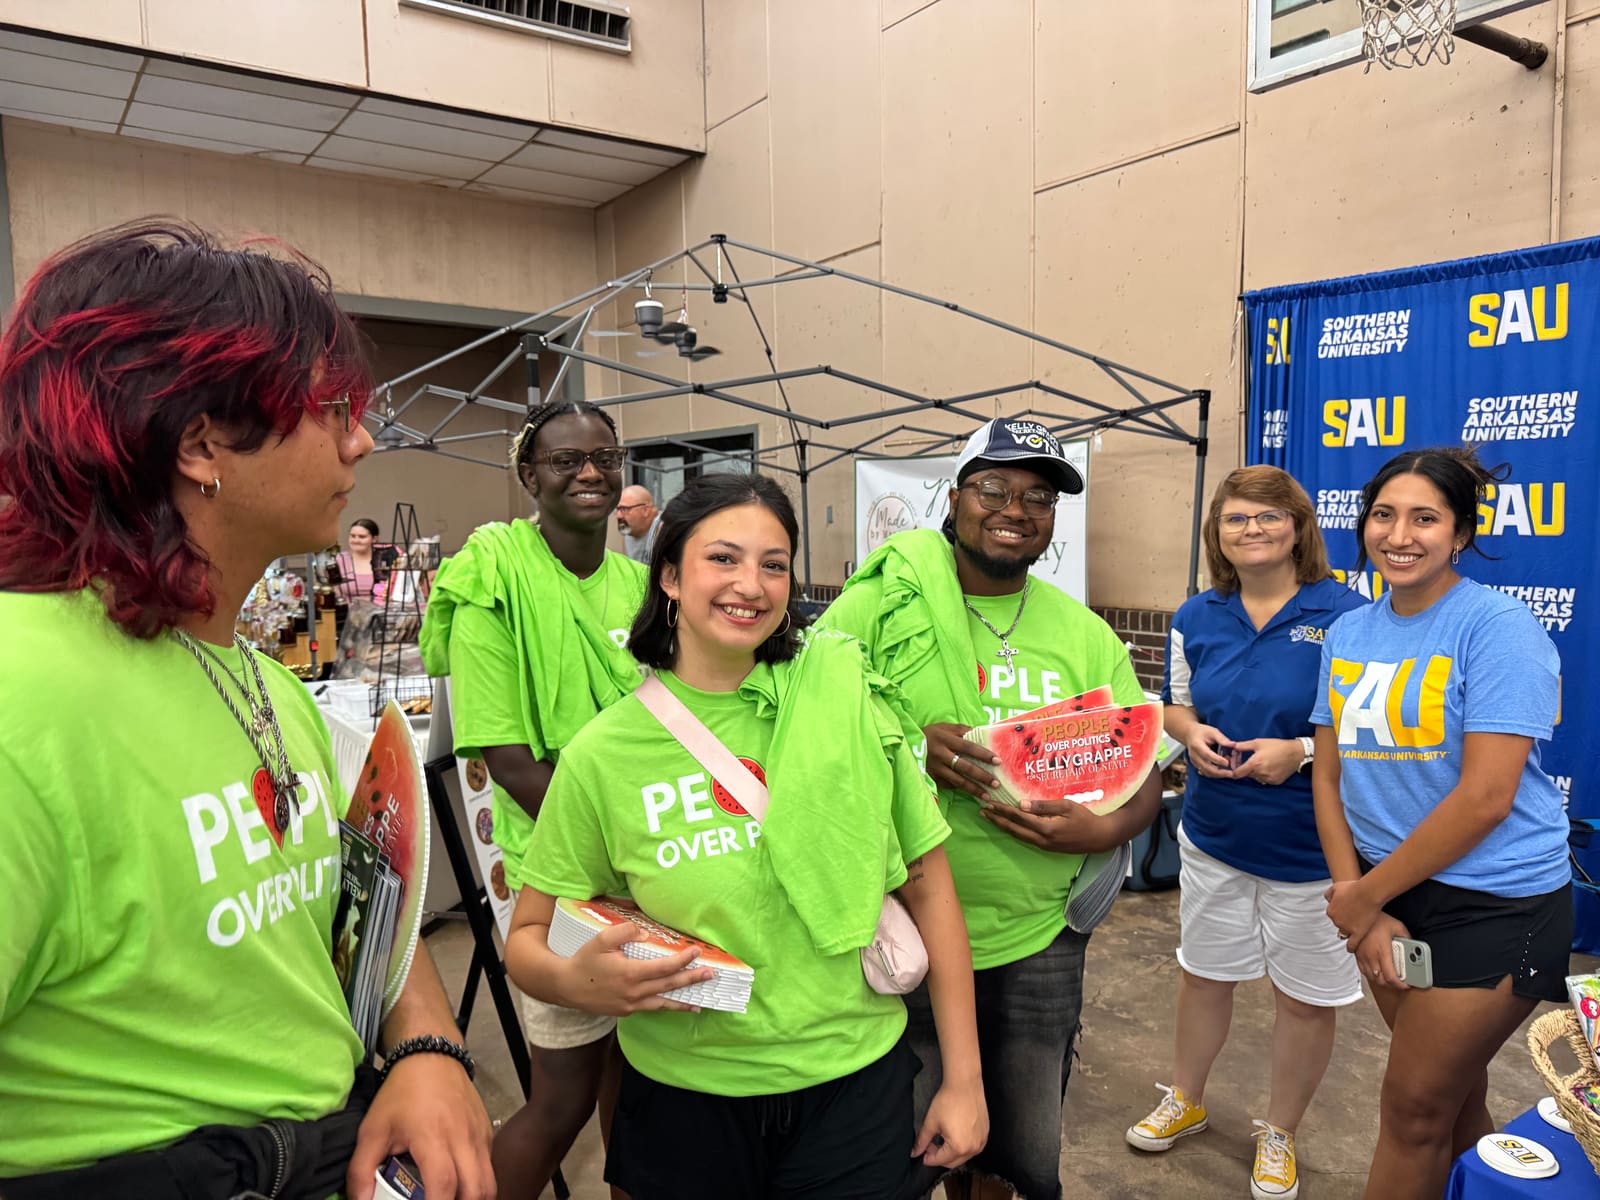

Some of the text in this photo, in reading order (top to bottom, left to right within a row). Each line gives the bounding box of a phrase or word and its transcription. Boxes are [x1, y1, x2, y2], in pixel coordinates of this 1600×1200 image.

[1322, 309, 1411, 332] SOUTHERN
[1469, 282, 1569, 348] SAU
[1318, 324, 1409, 346] ARKANSAS
[1317, 339, 1408, 359] UNIVERSITY
[1467, 391, 1578, 413] SOUTHERN
[1322, 396, 1406, 447] SAU
[1464, 407, 1576, 428] ARKANSAS
[1461, 422, 1575, 442] UNIVERSITY
[1317, 489, 1362, 503] SOUT
[876, 507, 908, 528] Made
[1316, 503, 1363, 516] ARKA
[1475, 482, 1566, 536] SAU
[1306, 626, 1328, 641] SA
[1328, 655, 1452, 747] SAU
[1043, 718, 1109, 741] PEOPLE
[1044, 734, 1111, 752] OVER POLITICS
[656, 826, 743, 869] OVER
[207, 872, 297, 947] OVER
[1496, 1139, 1544, 1164] SAU
